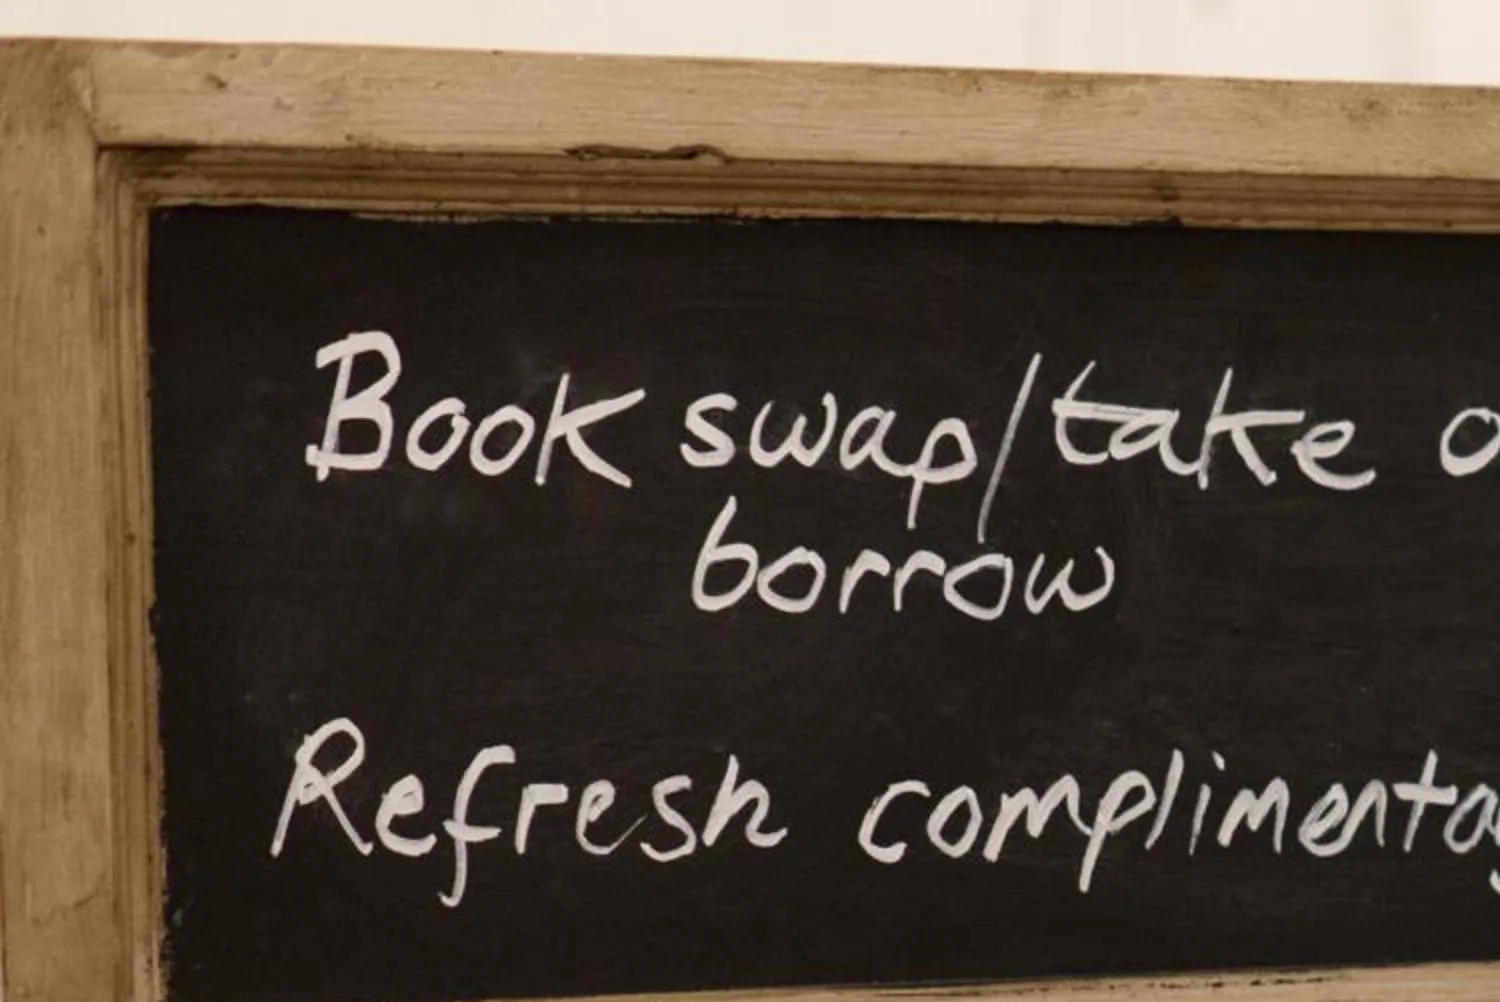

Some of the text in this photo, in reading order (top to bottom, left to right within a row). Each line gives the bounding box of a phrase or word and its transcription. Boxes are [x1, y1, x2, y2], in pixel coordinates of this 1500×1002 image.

[304, 329, 647, 489] Book
[691, 495, 1116, 621] borrow
[271, 717, 789, 907] Refresh
